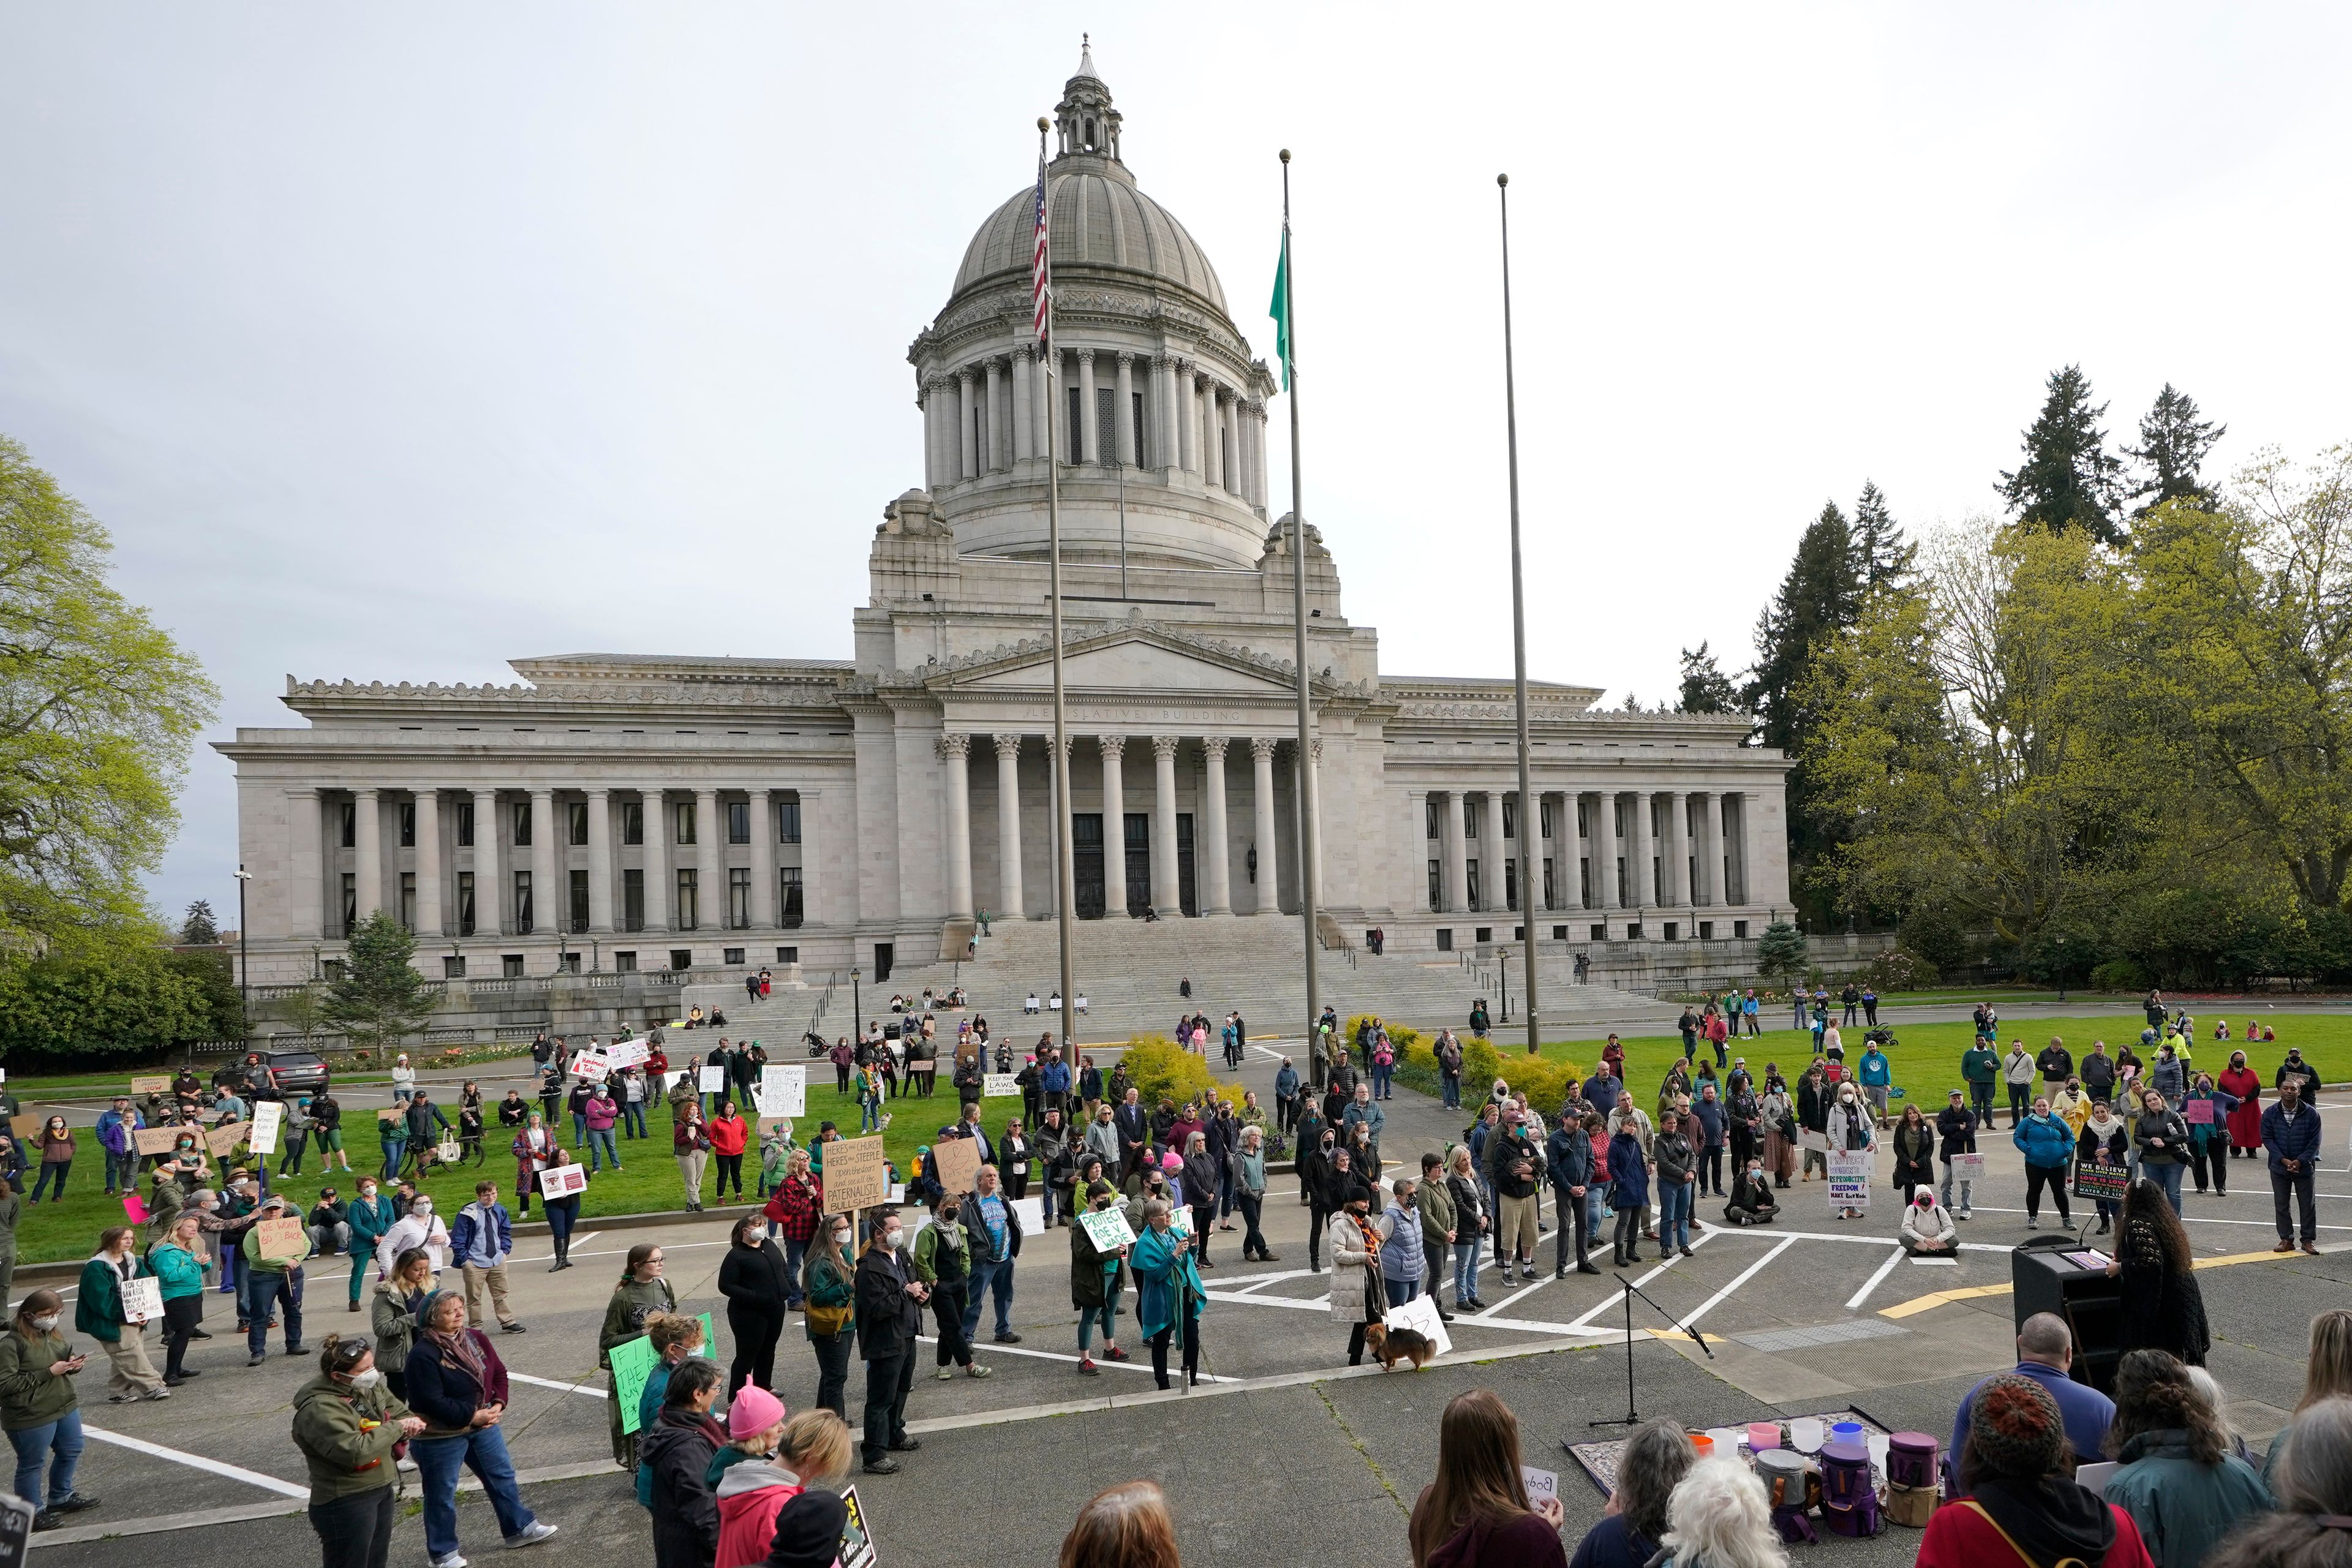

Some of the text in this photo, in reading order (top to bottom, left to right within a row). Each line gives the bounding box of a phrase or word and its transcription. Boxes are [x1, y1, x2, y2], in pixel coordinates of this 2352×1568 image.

[1032, 708, 1239, 720] LEISLATIVE BUILDING
[766, 1076, 793, 1084] HEALTH
[766, 1082, 797, 1092] SAFETY!
[765, 1099, 802, 1113] RIGHTS!
[136, 1129, 196, 1141] PRO-WON
[143, 1138, 176, 1147] PRO-CH
[209, 1136, 225, 1147] KEEP
[219, 1141, 235, 1151] SAFE
[826, 1144, 848, 1156] HERE'S
[857, 1139, 881, 1152] CHURCH
[855, 1151, 880, 1163] STEEPLE
[1829, 1155, 1865, 1165] PROTECT
[835, 1164, 875, 1180] open the doors
[944, 1169, 961, 1179] Let's
[1829, 1166, 1860, 1175] WOMEN'S
[834, 1178, 846, 1188] and
[856, 1175, 865, 1184] all
[827, 1183, 880, 1202] PATERNALISTIC
[831, 1196, 880, 1212] BULLSHIT
[982, 1210, 1007, 1219] HAMPION
[1082, 1209, 1121, 1229] PROTECT
[1170, 1209, 1182, 1224] OT
[260, 1223, 273, 1232] WE
[1093, 1224, 1120, 1242] ROE V
[261, 1231, 302, 1245] GO BACK
[1102, 1232, 1131, 1249] WADE
[124, 1281, 134, 1290] YOU
[613, 1348, 627, 1371] IF
[616, 1363, 645, 1390] THE
[624, 1387, 639, 1401] MY
